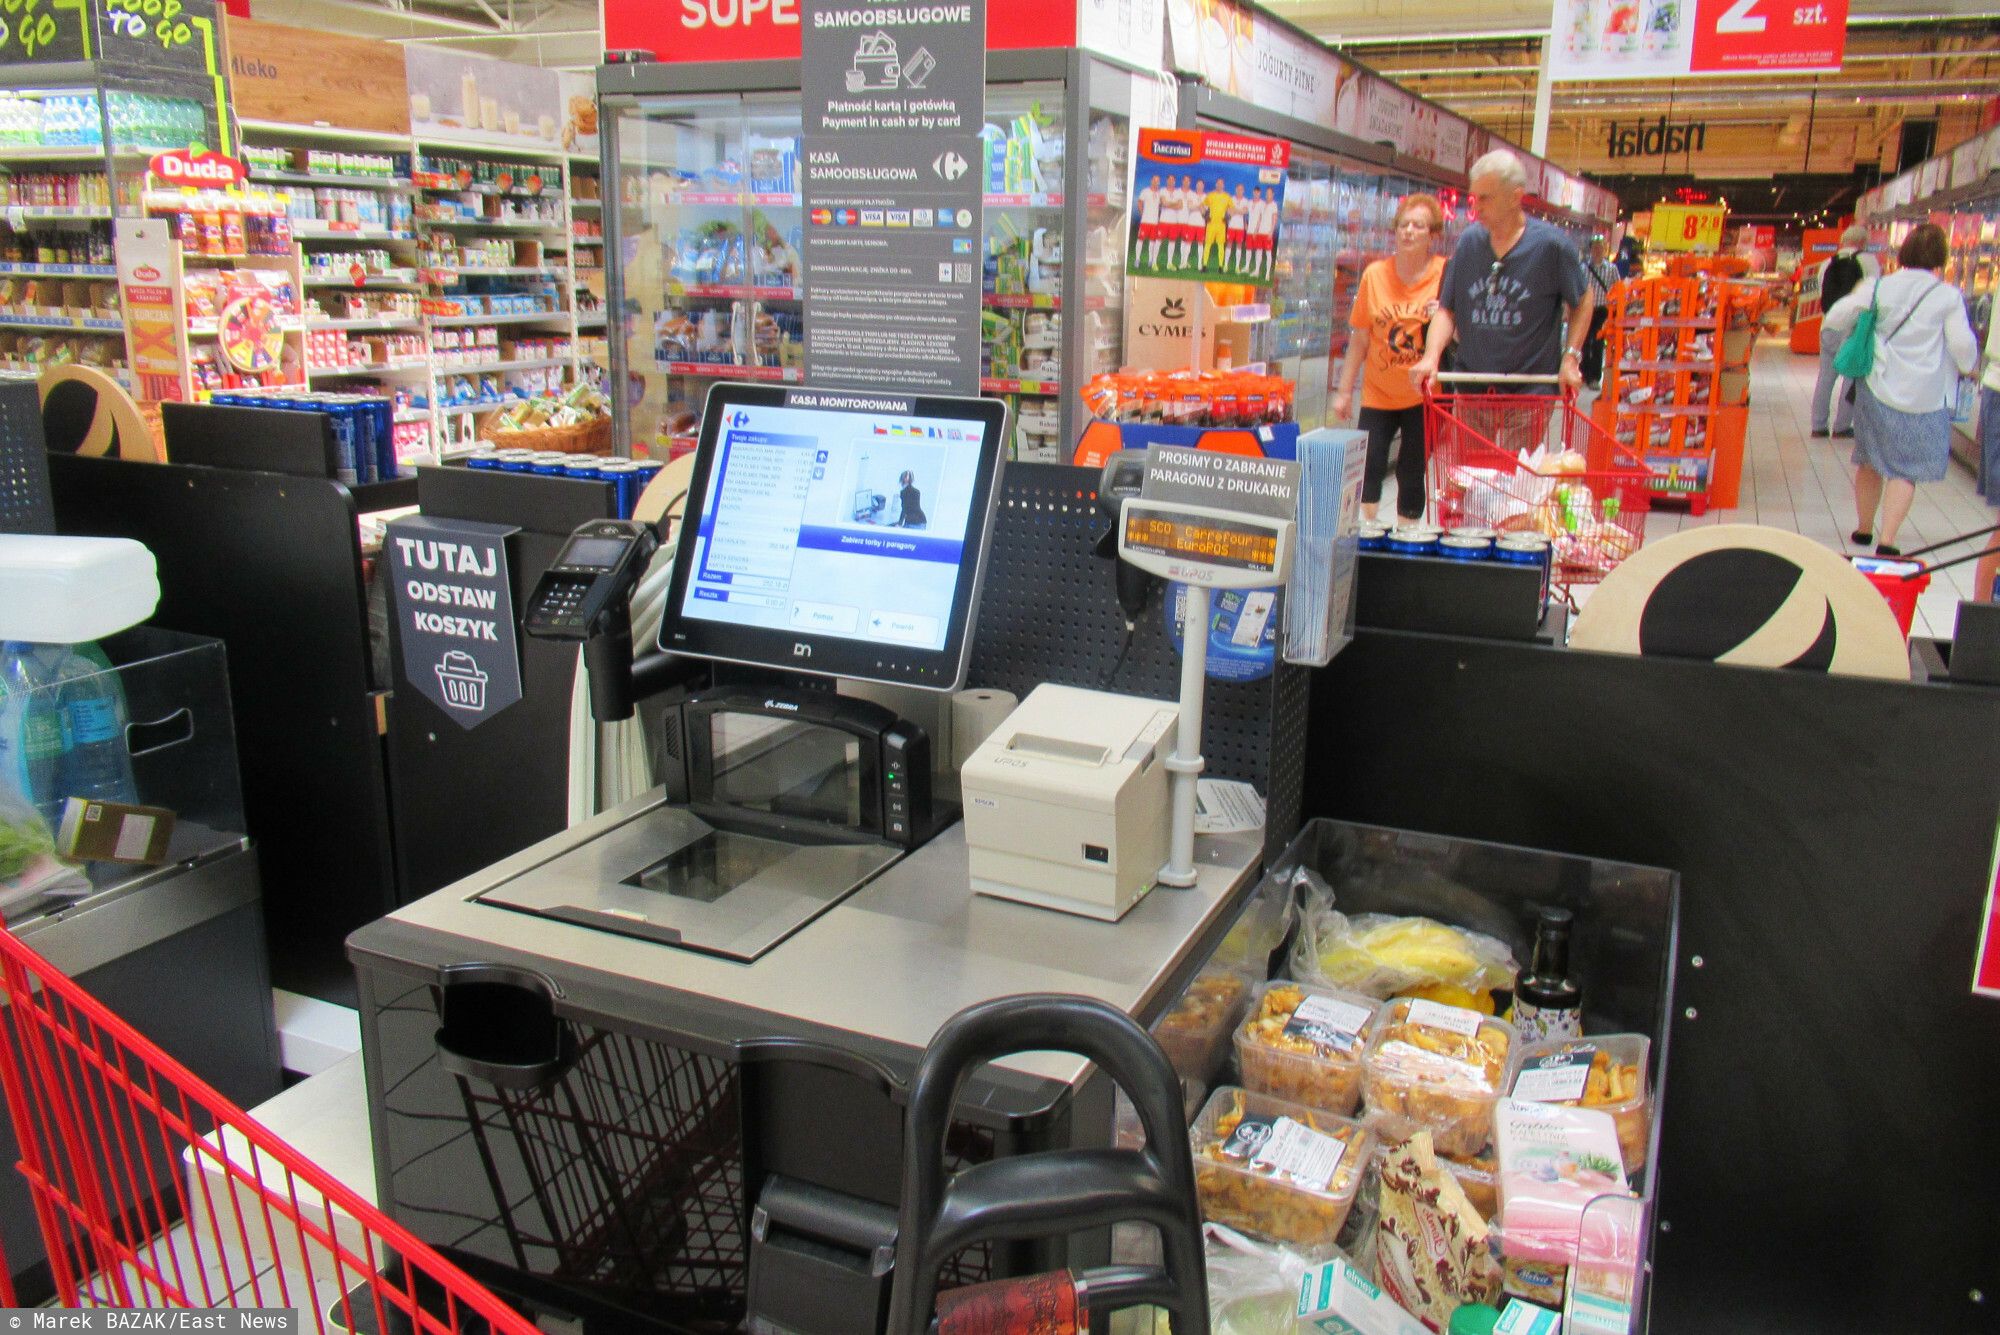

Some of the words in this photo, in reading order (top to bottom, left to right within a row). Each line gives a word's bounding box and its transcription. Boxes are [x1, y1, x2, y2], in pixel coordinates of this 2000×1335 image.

[814, 5, 971, 28] SAMOOBSŁUGOWE
[1793, 4, 1828, 26] szt.
[1258, 52, 1292, 83] JOGURTY
[828, 100, 872, 113] Płatność
[874, 100, 901, 113] kartą
[909, 98, 956, 113] gotówką
[822, 116, 867, 130] Payment
[869, 115, 879, 127] in
[881, 116, 906, 128] cash
[908, 117, 919, 127] or
[921, 115, 935, 129] by
[937, 115, 961, 127] card
[162, 156, 234, 180] Duda
[809, 152, 840, 164] KASA
[810, 168, 918, 180] SAMOOBSŁUGOWA
[891, 213, 906, 221] VISA
[1471, 310, 1523, 327] BLUES
[790, 394, 818, 407] KASA
[819, 398, 908, 413] MONITOROWANA
[1158, 450, 1211, 469] PROSIMY
[1213, 457, 1222, 470] O
[1225, 459, 1287, 479] ZABRANIE
[1150, 468, 1215, 488] PARAGONU
[1217, 478, 1224, 490] Z
[1227, 478, 1291, 499] DRUKARKI
[1176, 538, 1229, 555] EuroPOS
[1185, 525, 1253, 546] Carrefour
[396, 538, 497, 577] TUTAJ
[407, 580, 497, 610] ODSTAW
[414, 611, 498, 641] KOSZYK
[1346, 1266, 1376, 1298] elmex
